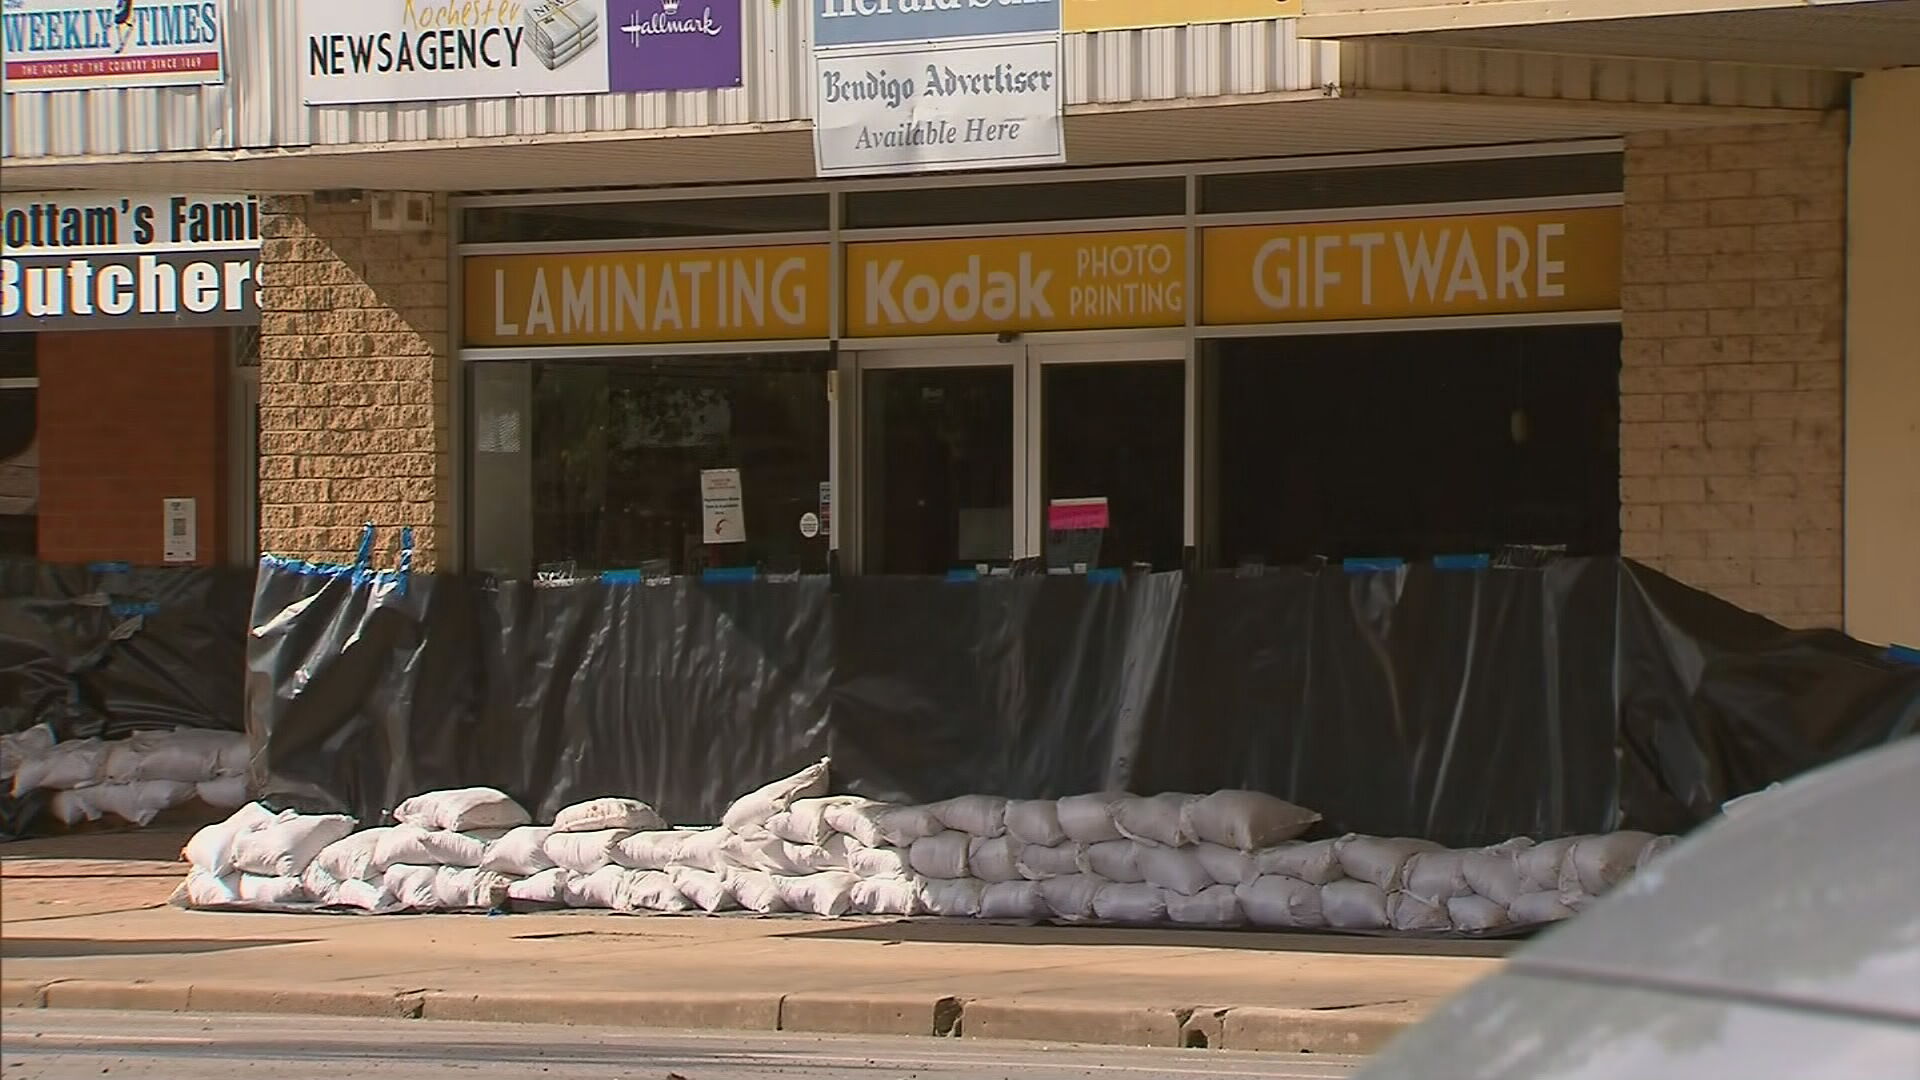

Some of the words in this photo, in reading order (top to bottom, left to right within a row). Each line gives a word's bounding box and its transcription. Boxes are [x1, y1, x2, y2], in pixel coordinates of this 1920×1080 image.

[3, 8, 112, 52] WEEKLY
[133, 3, 217, 46] TIMES
[310, 27, 523, 76] NEWSAGENCY
[620, 7, 721, 48] Hallmark
[22, 64, 37, 76] THE
[42, 63, 68, 74] VOICE
[88, 61, 104, 73] THE
[108, 60, 146, 72] COUNTRY
[151, 58, 177, 70] SINCE
[823, 70, 914, 108] Bendigo
[923, 63, 1053, 97] Advertiser
[855, 120, 957, 149] Available
[963, 118, 1020, 143] Here
[0, 198, 155, 248] ottam's
[170, 194, 259, 243] Fami
[1076, 243, 1172, 279] PHOTO
[1252, 222, 1566, 311] GIFTWARE
[0, 255, 263, 318] Butcher
[494, 256, 808, 337] LAMINATING
[864, 251, 1055, 326] Kodak
[1069, 281, 1183, 317] PRINTING
